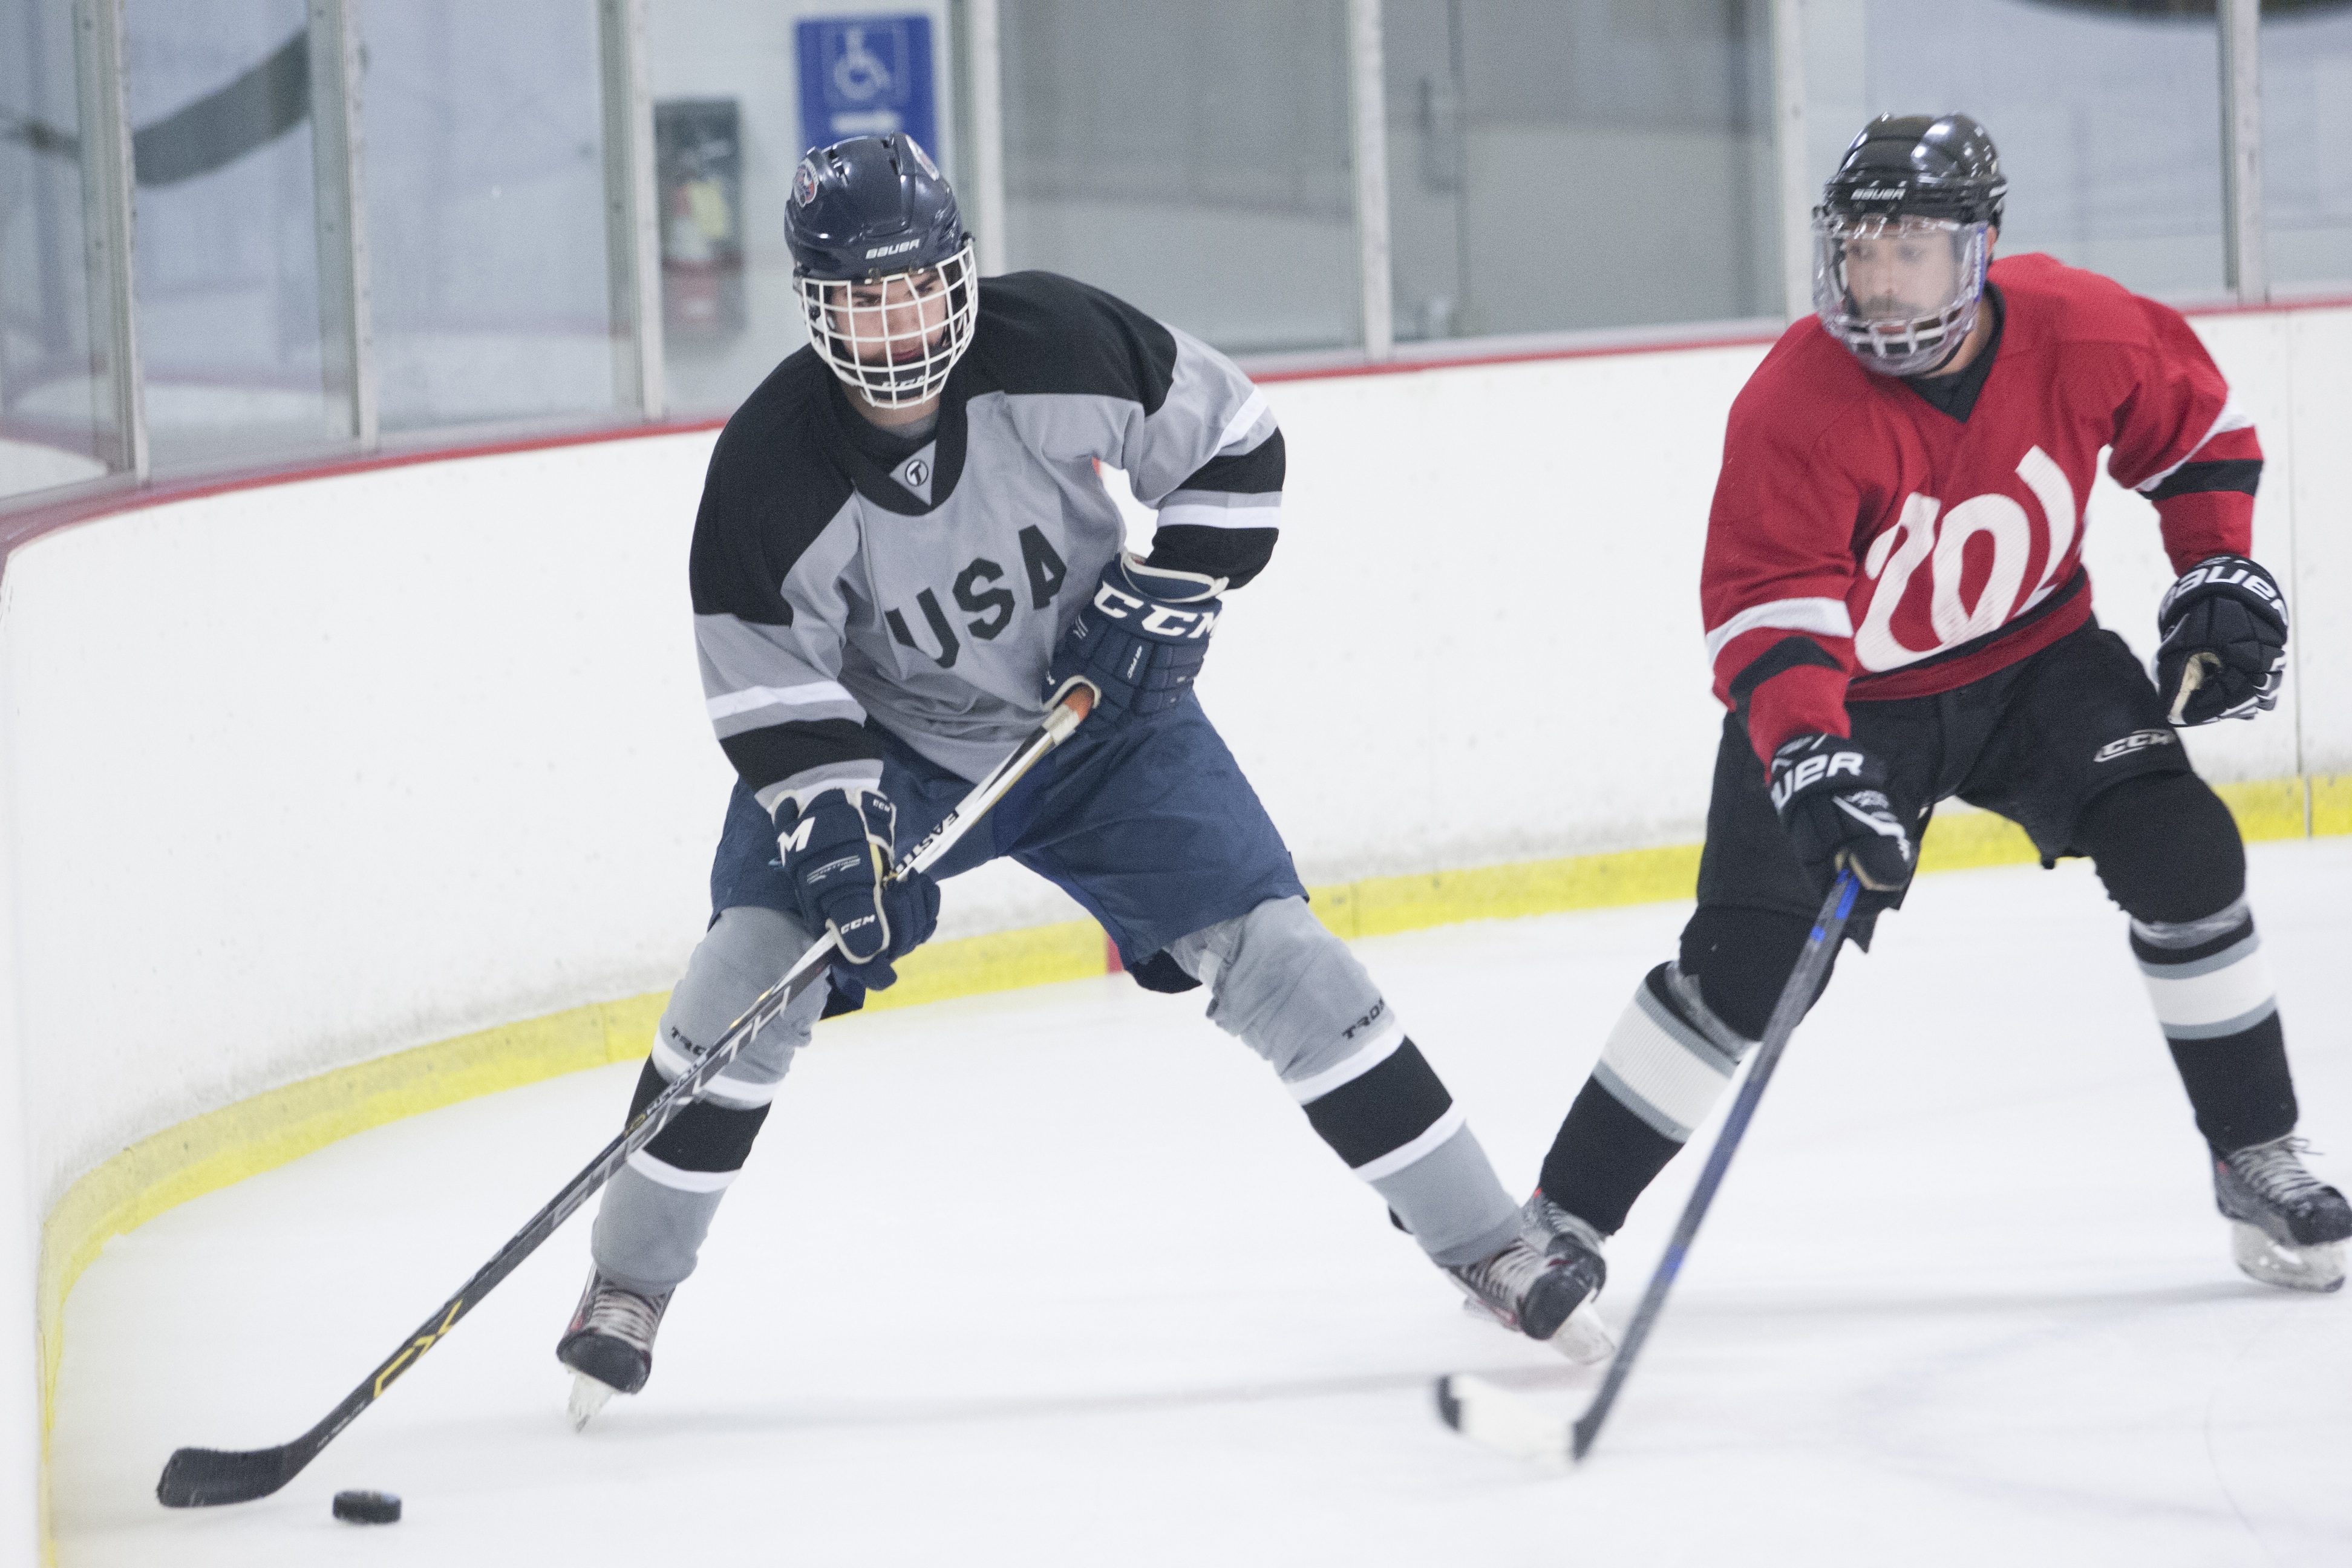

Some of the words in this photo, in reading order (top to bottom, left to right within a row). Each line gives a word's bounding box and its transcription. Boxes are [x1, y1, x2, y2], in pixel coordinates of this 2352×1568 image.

[866, 238, 920, 260] BAUER
[884, 524, 1068, 668] USA
[1094, 581, 1223, 639] CCM
[2098, 731, 2173, 757] CCM
[1771, 751, 1864, 814] UER
[892, 808, 961, 877] EASTO
[840, 914, 876, 935] CCM
